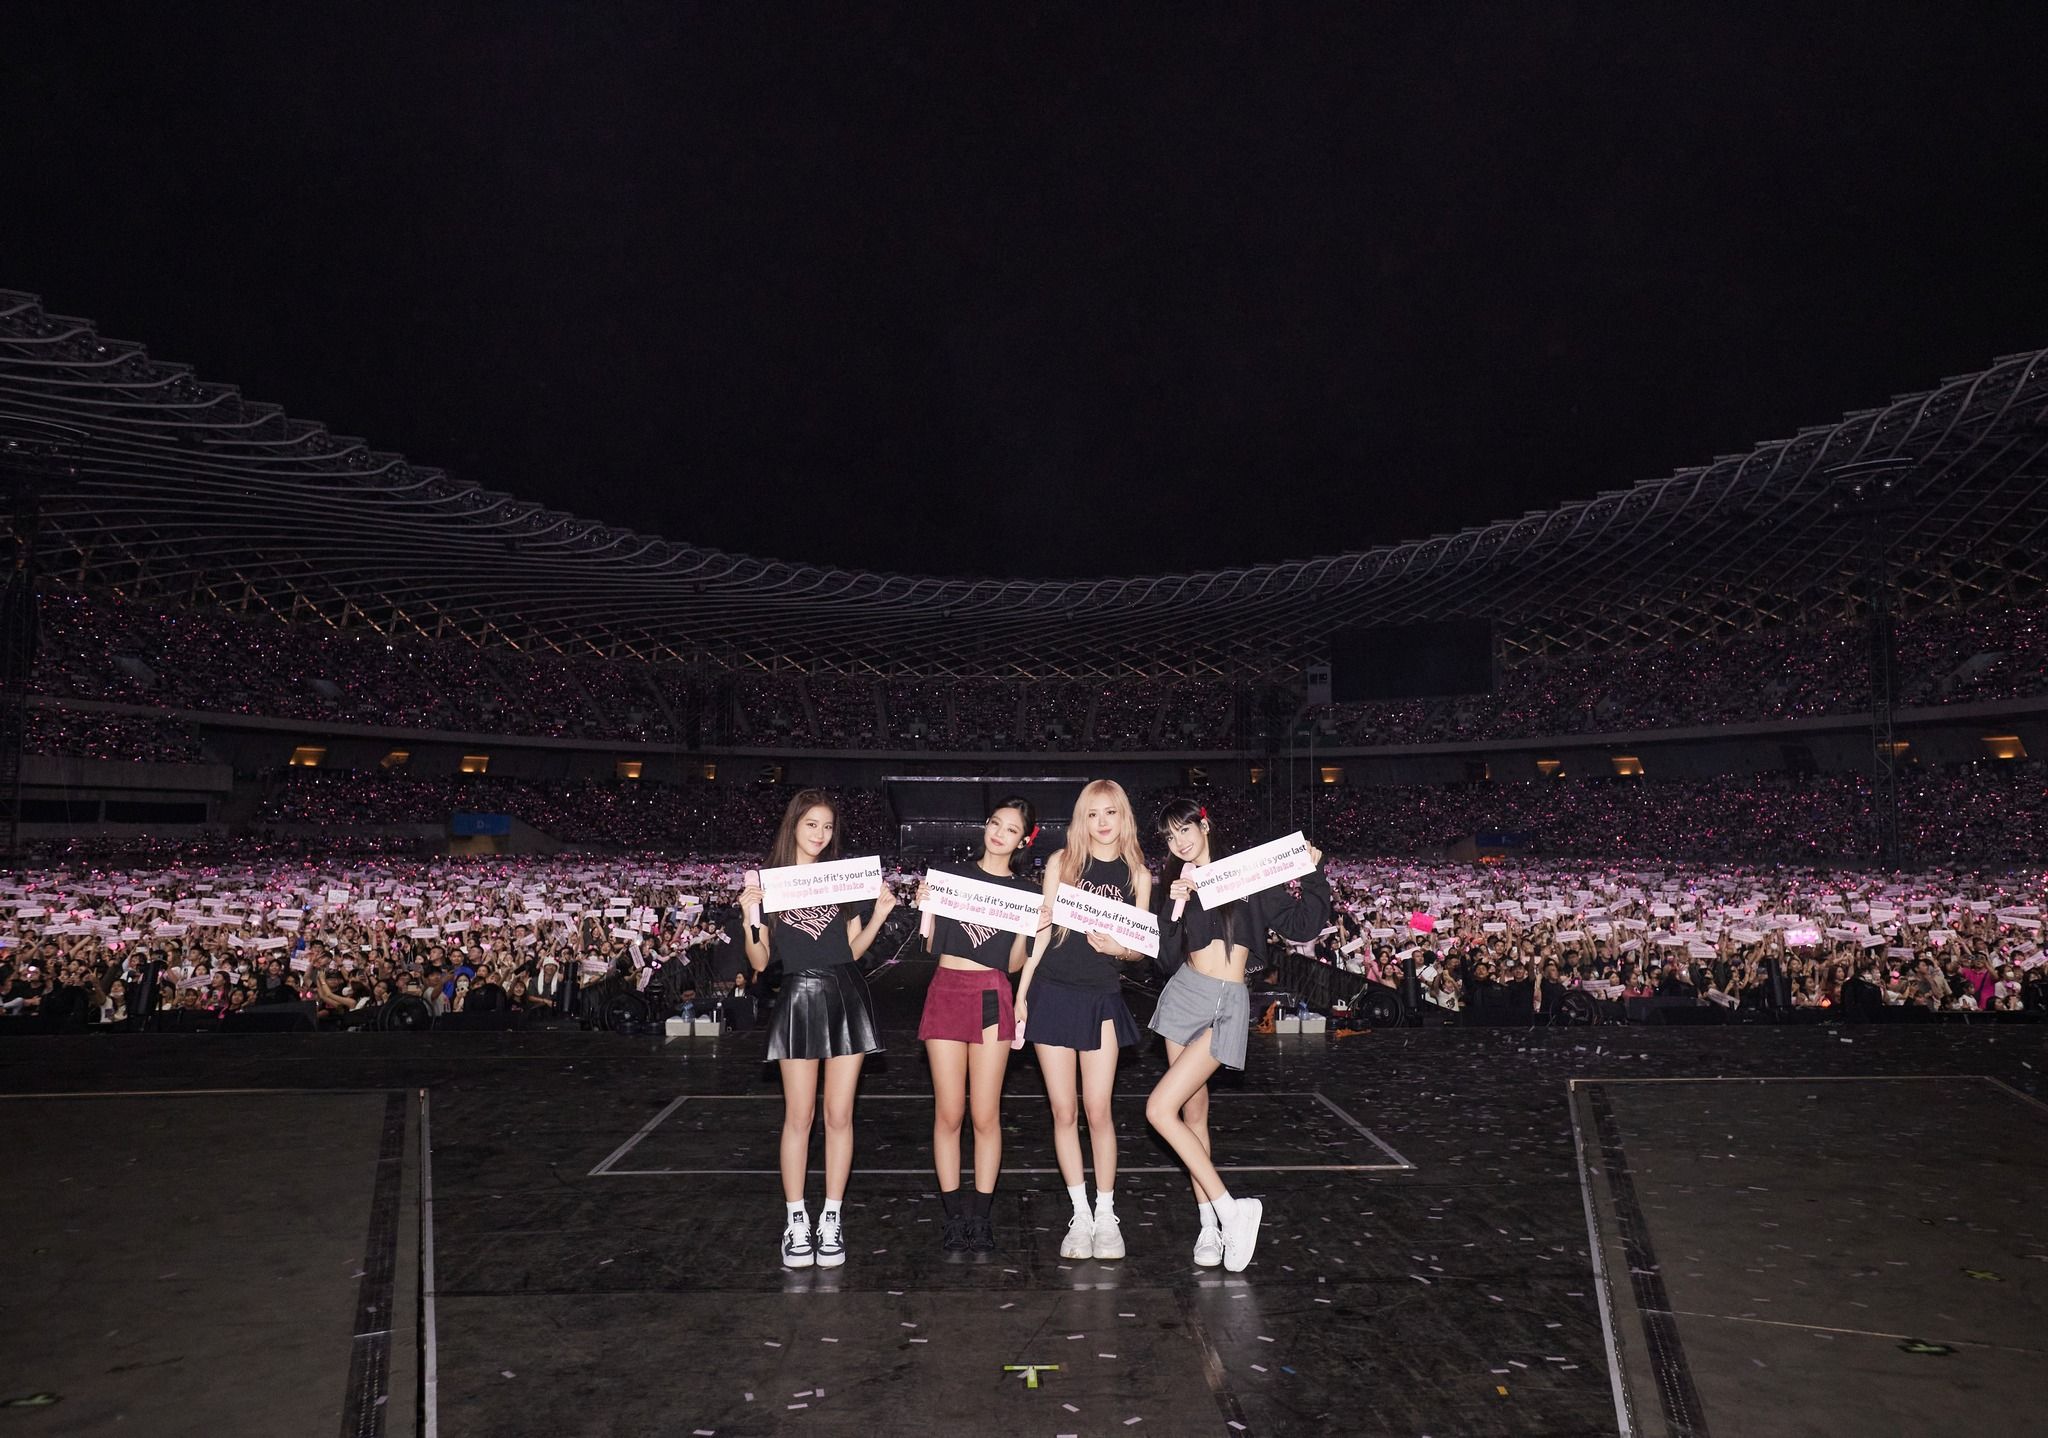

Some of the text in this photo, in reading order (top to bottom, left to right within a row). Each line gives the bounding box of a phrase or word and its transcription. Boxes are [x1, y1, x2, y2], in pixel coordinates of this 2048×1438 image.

[792, 878, 812, 887] Stay
[812, 876, 823, 884] As
[823, 873, 831, 882] if
[830, 872, 844, 882] it's
[844, 871, 864, 882] your
[864, 869, 880, 877] last
[1195, 878, 1215, 889] Love
[1272, 851, 1291, 864] your
[1291, 844, 1307, 855] last
[945, 886, 953, 896] Is
[973, 893, 984, 903] As
[984, 895, 991, 904] if
[990, 896, 1004, 907] it's
[1004, 901, 1025, 911] your
[1056, 895, 1076, 908] Love
[1075, 901, 1083, 910] Is
[1083, 903, 1102, 917] Stay
[1101, 910, 1112, 919] As
[1112, 912, 1120, 921] if
[1119, 914, 1131, 926] it's
[1130, 920, 1149, 932] your
[1116, 926, 1145, 941] Blinks
